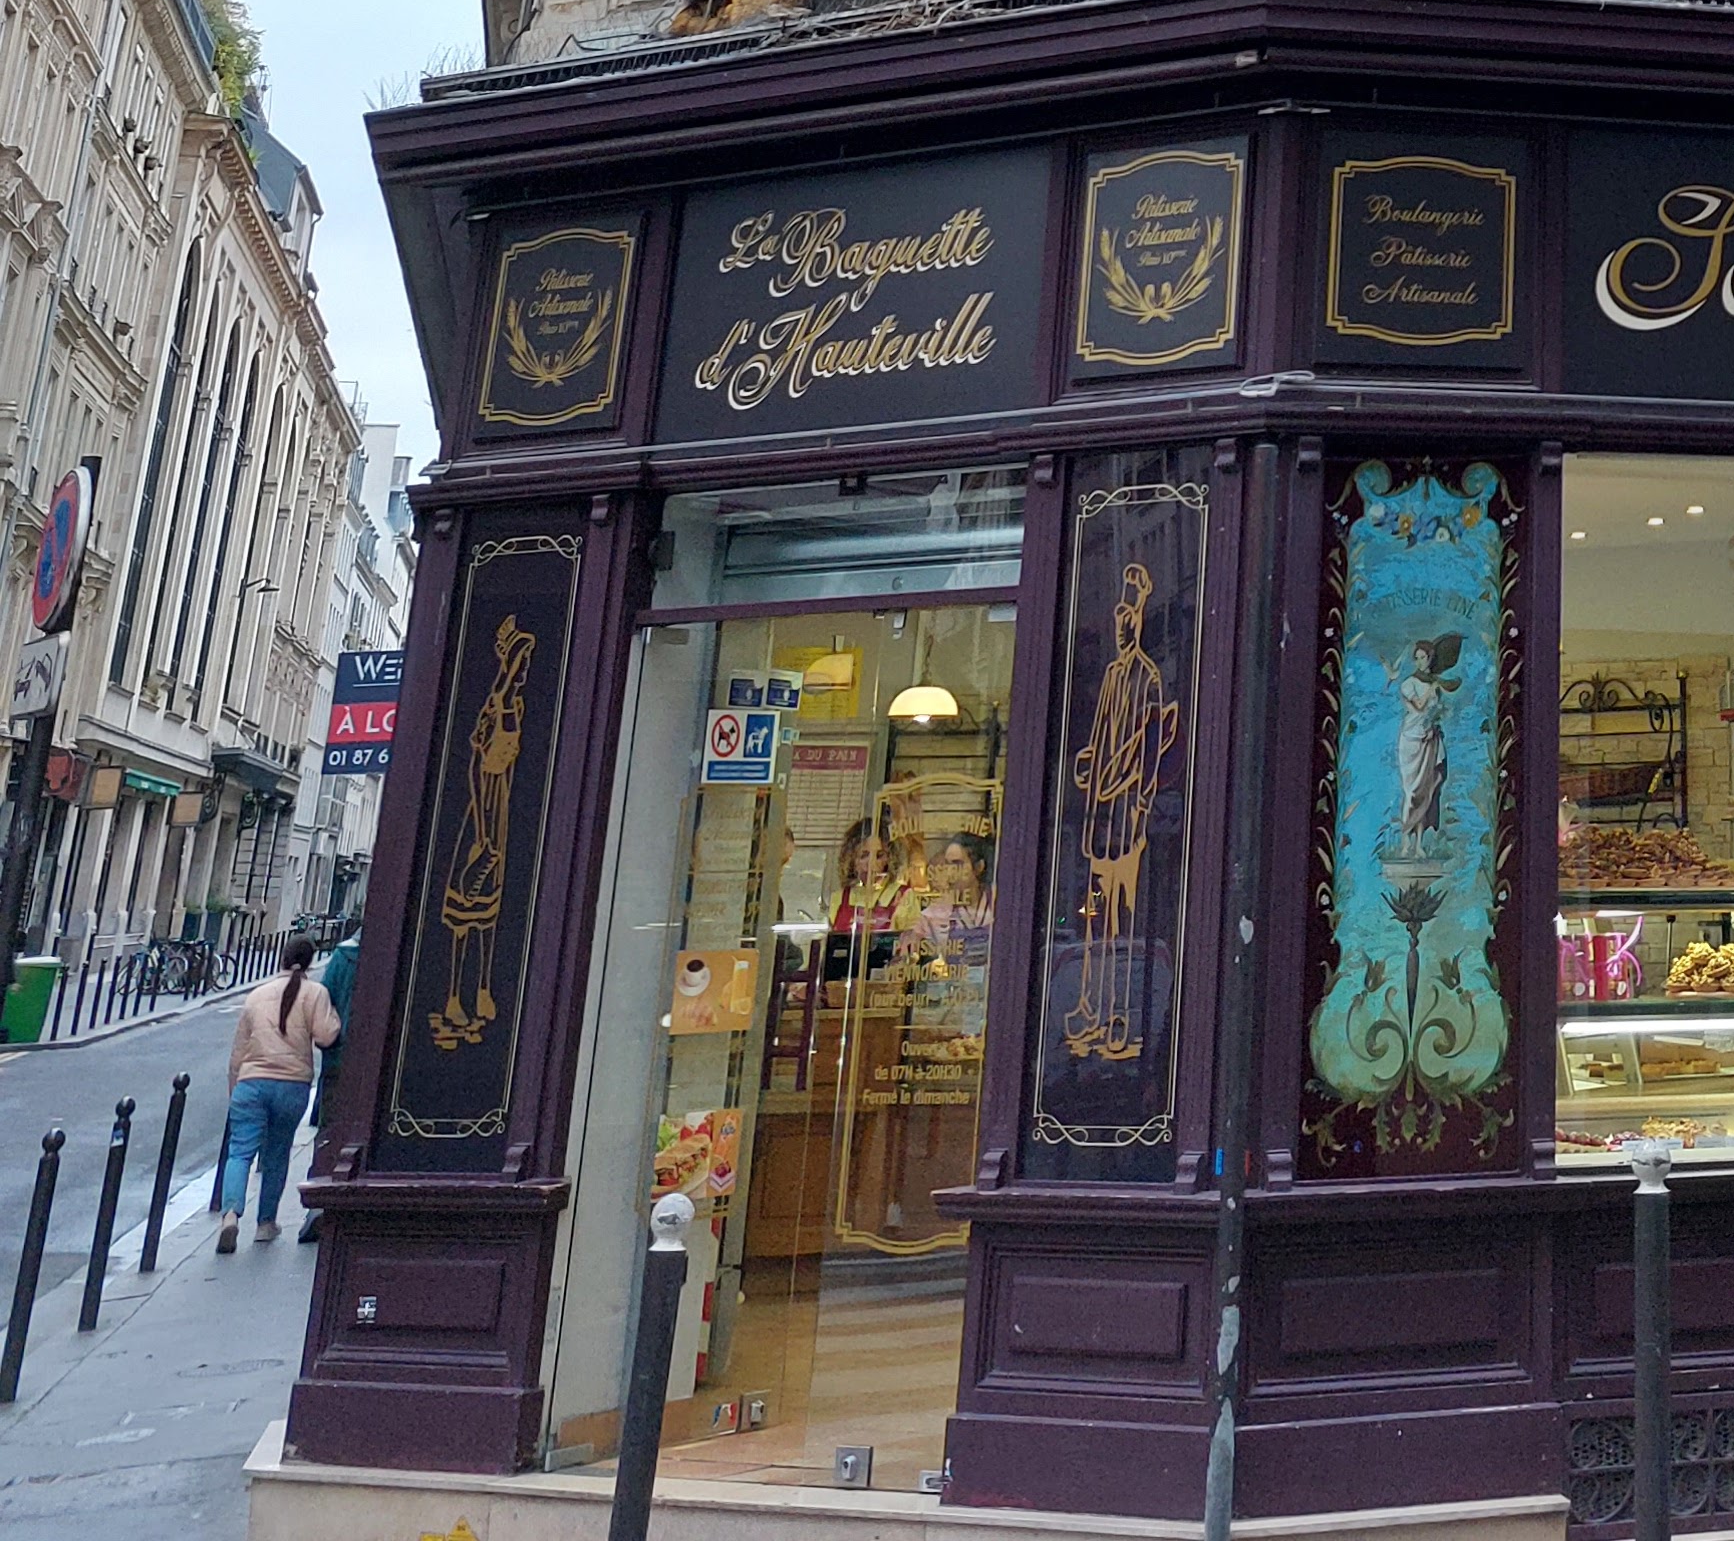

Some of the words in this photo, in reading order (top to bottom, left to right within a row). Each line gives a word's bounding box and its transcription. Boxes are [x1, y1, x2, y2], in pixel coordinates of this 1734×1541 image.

[1362, 194, 1485, 237] Boulangerie
[719, 209, 782, 274] La
[767, 206, 996, 312] Baguette
[1362, 275, 1480, 304] Artisanale
[695, 291, 998, 410] d'Hauteville
[1370, 587, 1441, 617] TISSERIE
[336, 705, 355, 735] À
[328, 750, 347, 766] 01
[352, 749, 374, 766] 87
